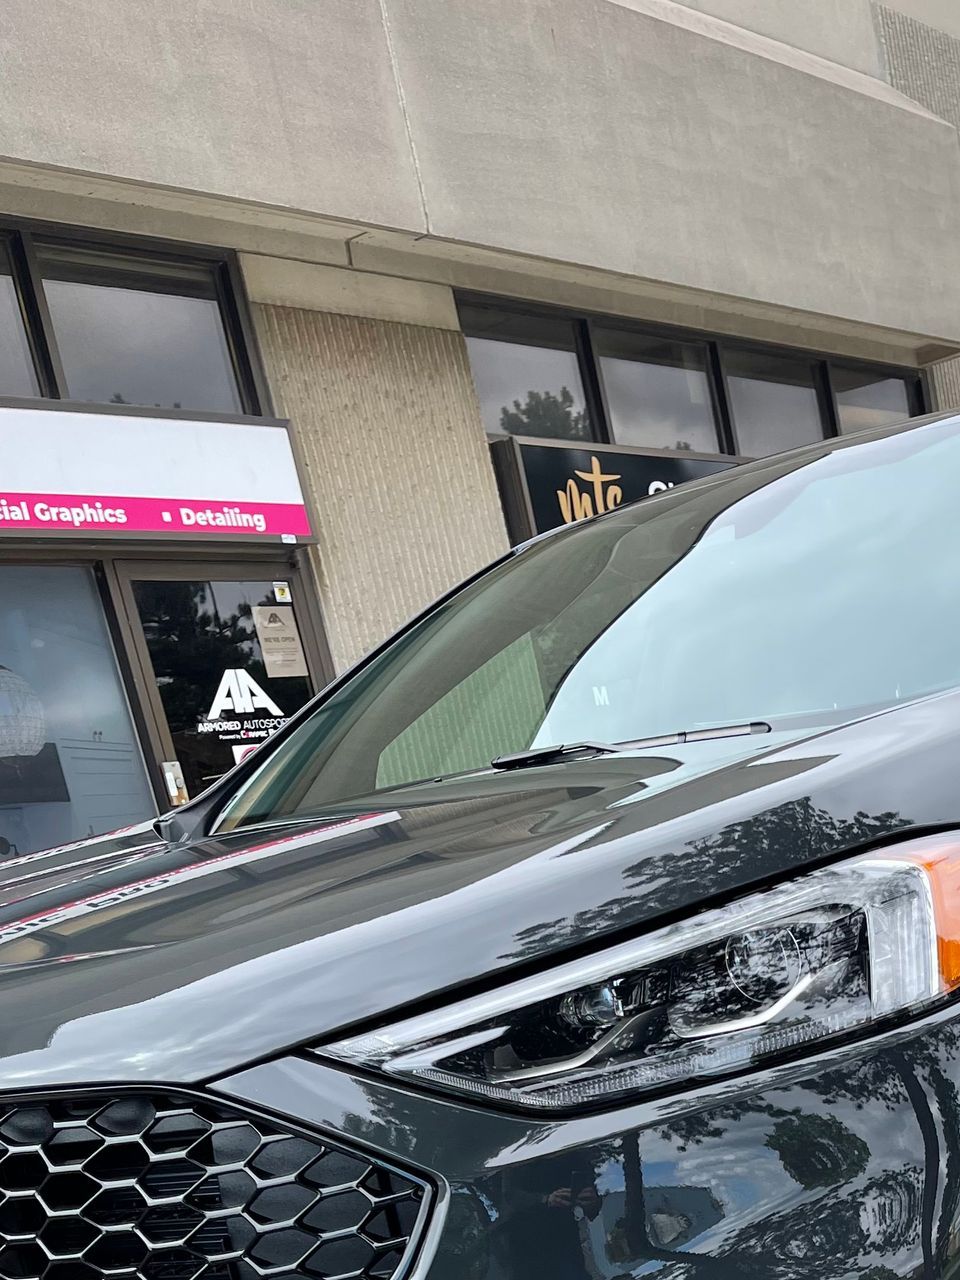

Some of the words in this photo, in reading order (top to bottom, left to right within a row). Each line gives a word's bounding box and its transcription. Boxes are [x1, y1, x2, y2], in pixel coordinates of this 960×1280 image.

[34, 501, 127, 527] Graphics
[180, 507, 266, 531] Detailing
[592, 686, 610, 706] M
[198, 720, 241, 732] ARMORED
